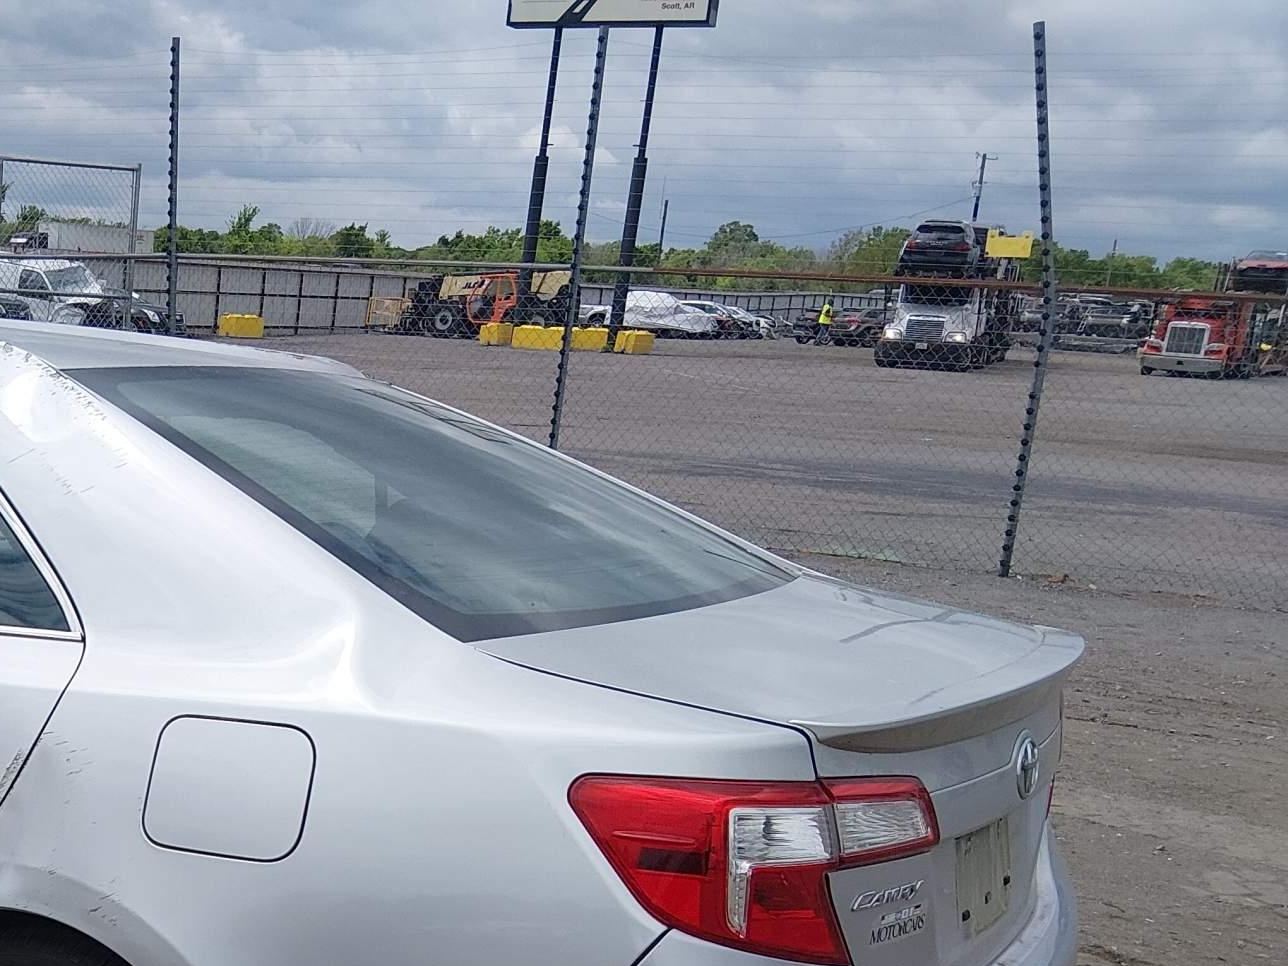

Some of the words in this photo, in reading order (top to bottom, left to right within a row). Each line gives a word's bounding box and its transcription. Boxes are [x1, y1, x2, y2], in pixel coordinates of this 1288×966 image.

[661, 2, 682, 10] Scott,
[851, 880, 924, 911] CAMRY
[869, 914, 926, 945] MOTORCARS
